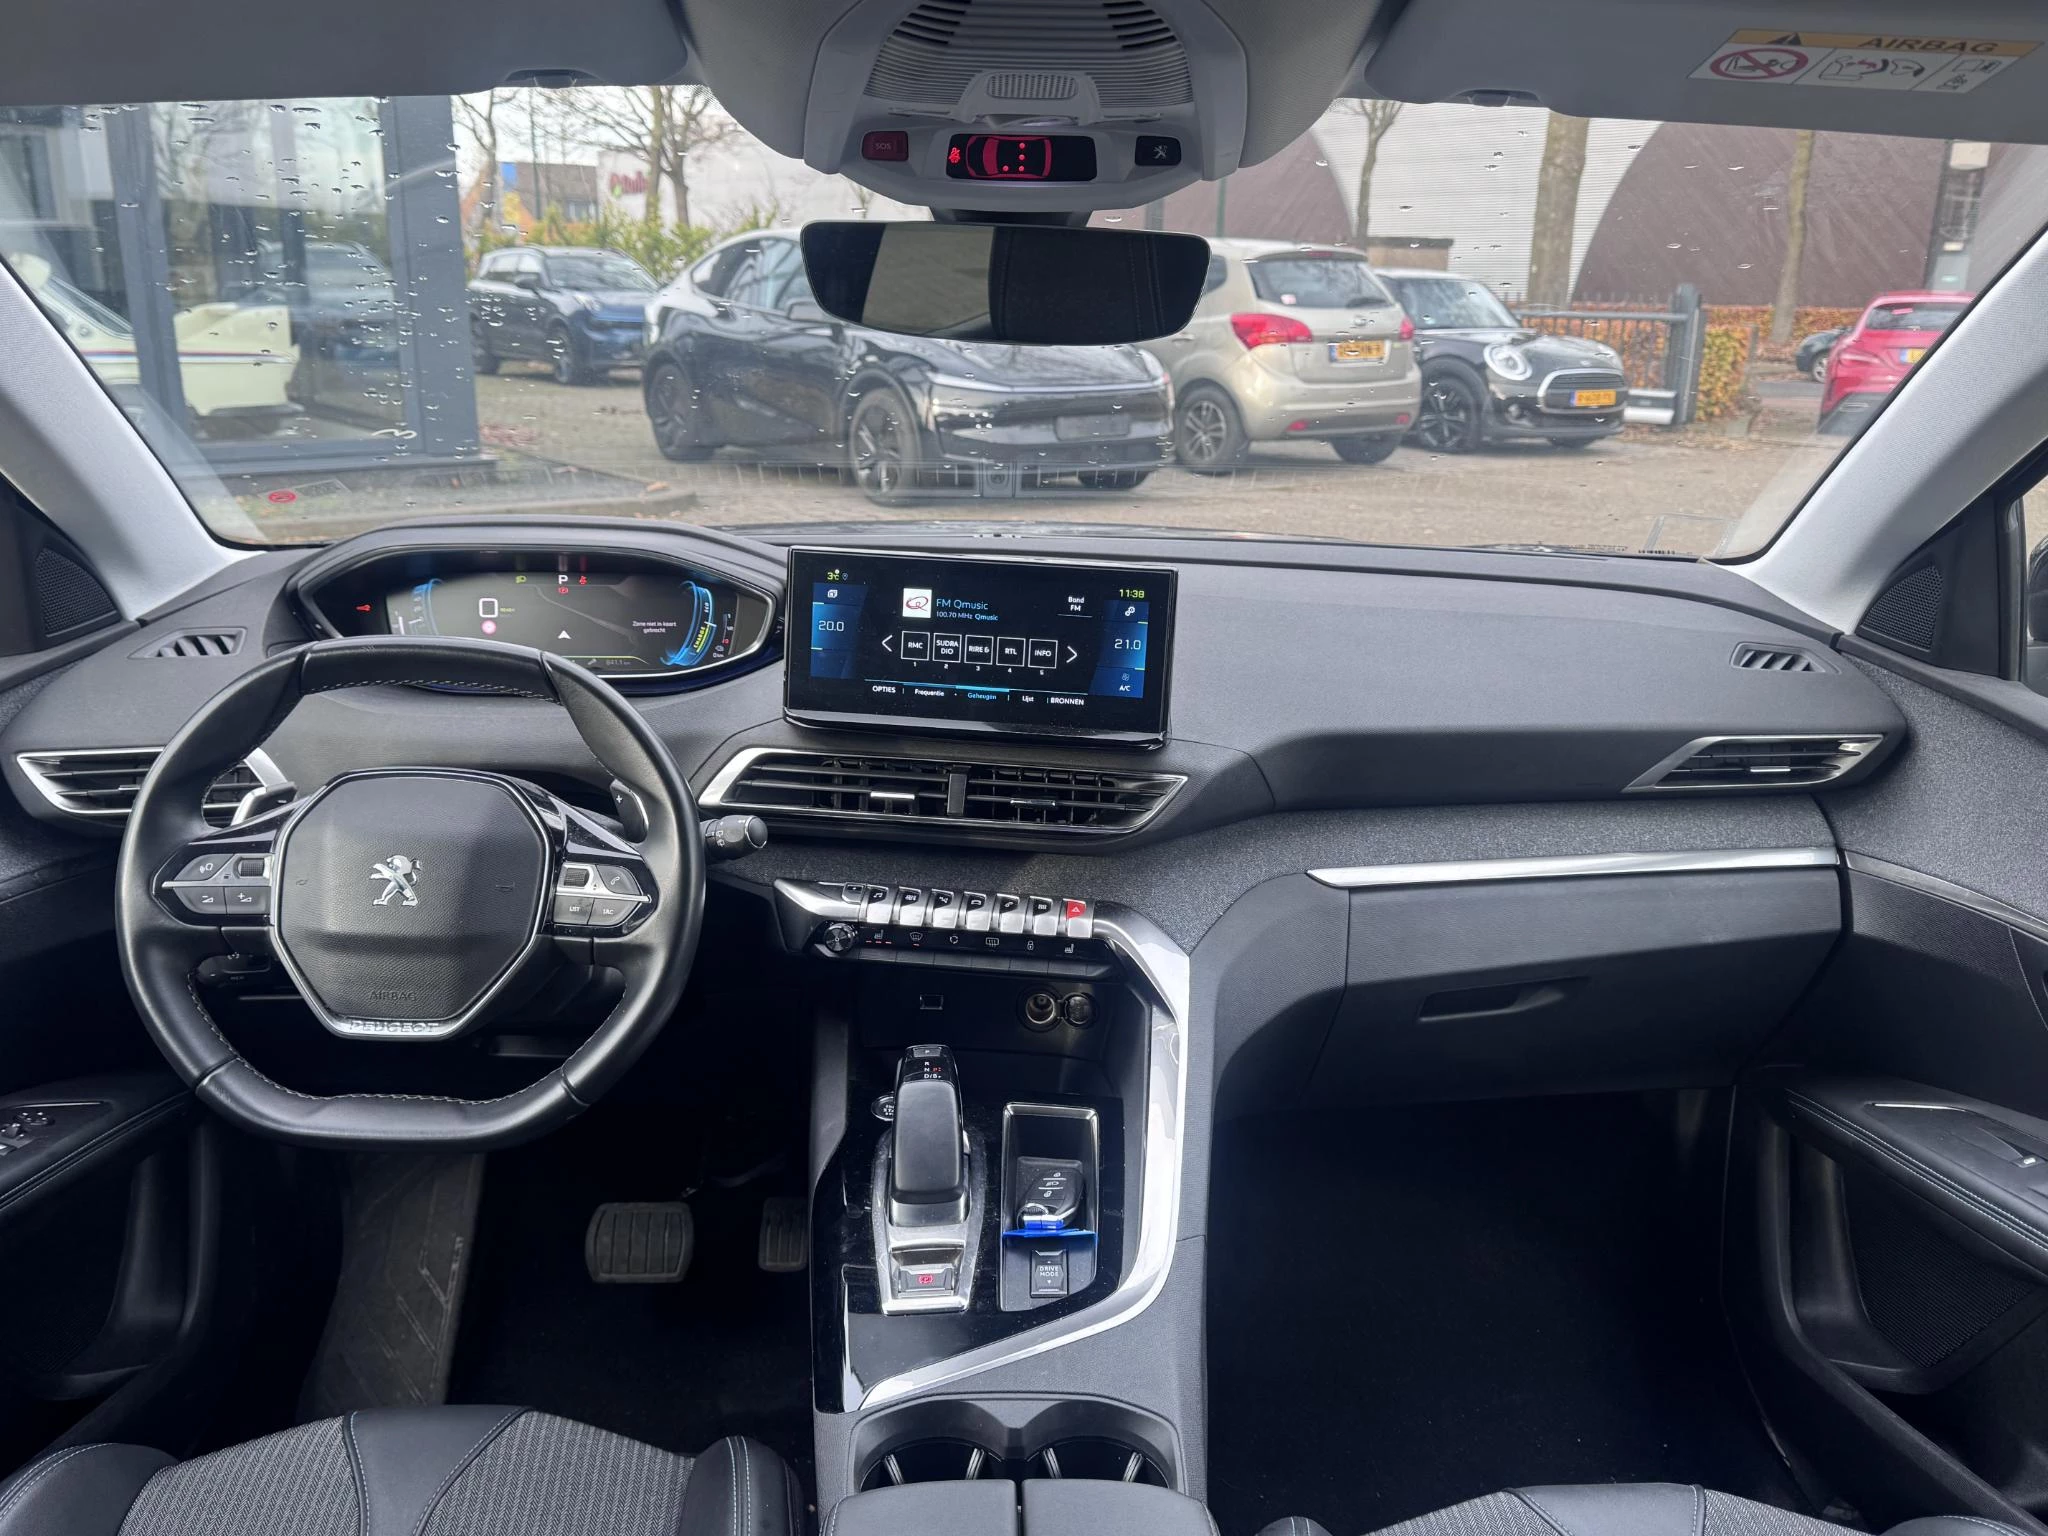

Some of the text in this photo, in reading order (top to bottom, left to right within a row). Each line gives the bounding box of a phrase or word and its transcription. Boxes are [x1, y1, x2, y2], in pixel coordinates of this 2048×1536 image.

[1858, 37, 1999, 53] AIRBAG
[875, 142, 892, 151] SOS
[558, 574, 569, 585] P
[1119, 589, 1145, 598] 11:38
[936, 598, 989, 611] FM Qmusic
[1068, 596, 1085, 604] Band
[1070, 604, 1081, 612] FM
[936, 611, 999, 621] 100.70 MHz Qmusic
[818, 620, 845, 632] 20.0
[908, 641, 924, 649] RMC
[936, 639, 959, 648] SUDRA
[1114, 638, 1141, 650] 21.0
[941, 647, 954, 655] DIO
[968, 645, 983, 653] RIRE
[872, 685, 1085, 706] OPTIES Frequentie Geheugen Lijst BRONNEN
[370, 991, 417, 1000] AIRBAG
[350, 1020, 440, 1032] PEUGEOT
